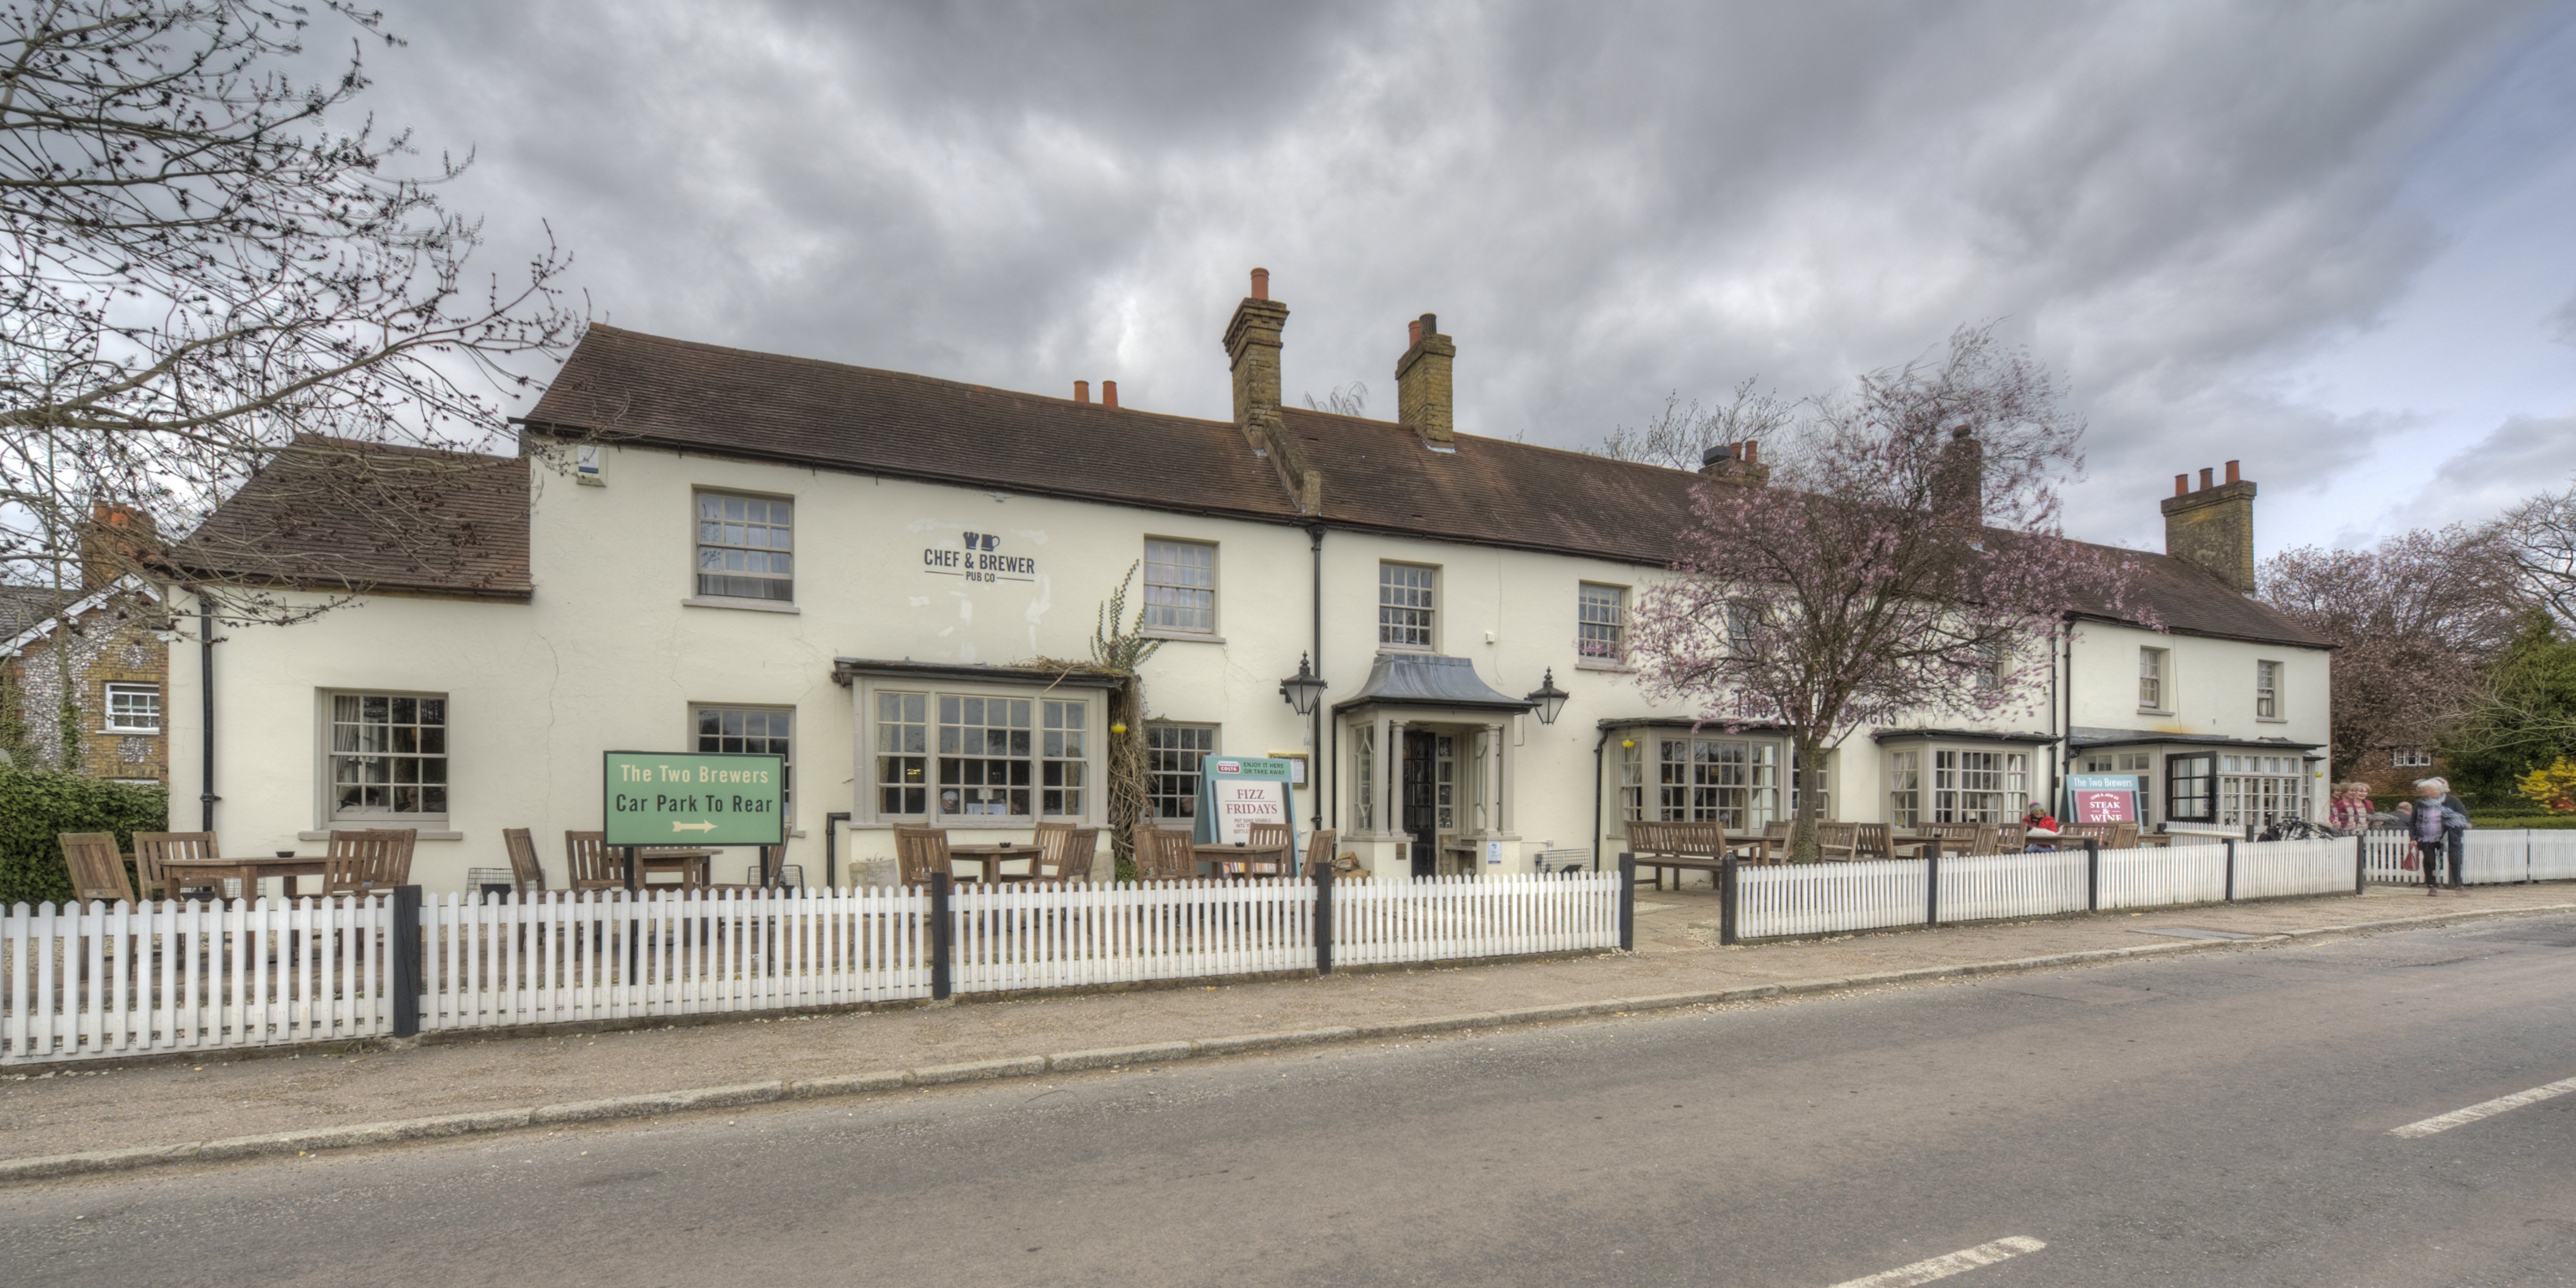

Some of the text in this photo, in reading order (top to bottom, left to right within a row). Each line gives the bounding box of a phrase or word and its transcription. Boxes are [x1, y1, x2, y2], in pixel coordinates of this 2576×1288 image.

[924, 548, 1035, 574] CHEF & BREWER
[965, 571, 995, 583] PUB CO
[620, 764, 769, 783] The Two Brewers
[2073, 777, 2132, 787] The Two Brewers
[1237, 789, 1265, 799] FIZZ
[616, 794, 772, 812] Car Park To Rear
[1226, 804, 1277, 814] FRIDAYS
[2090, 814, 2123, 822] WINE
